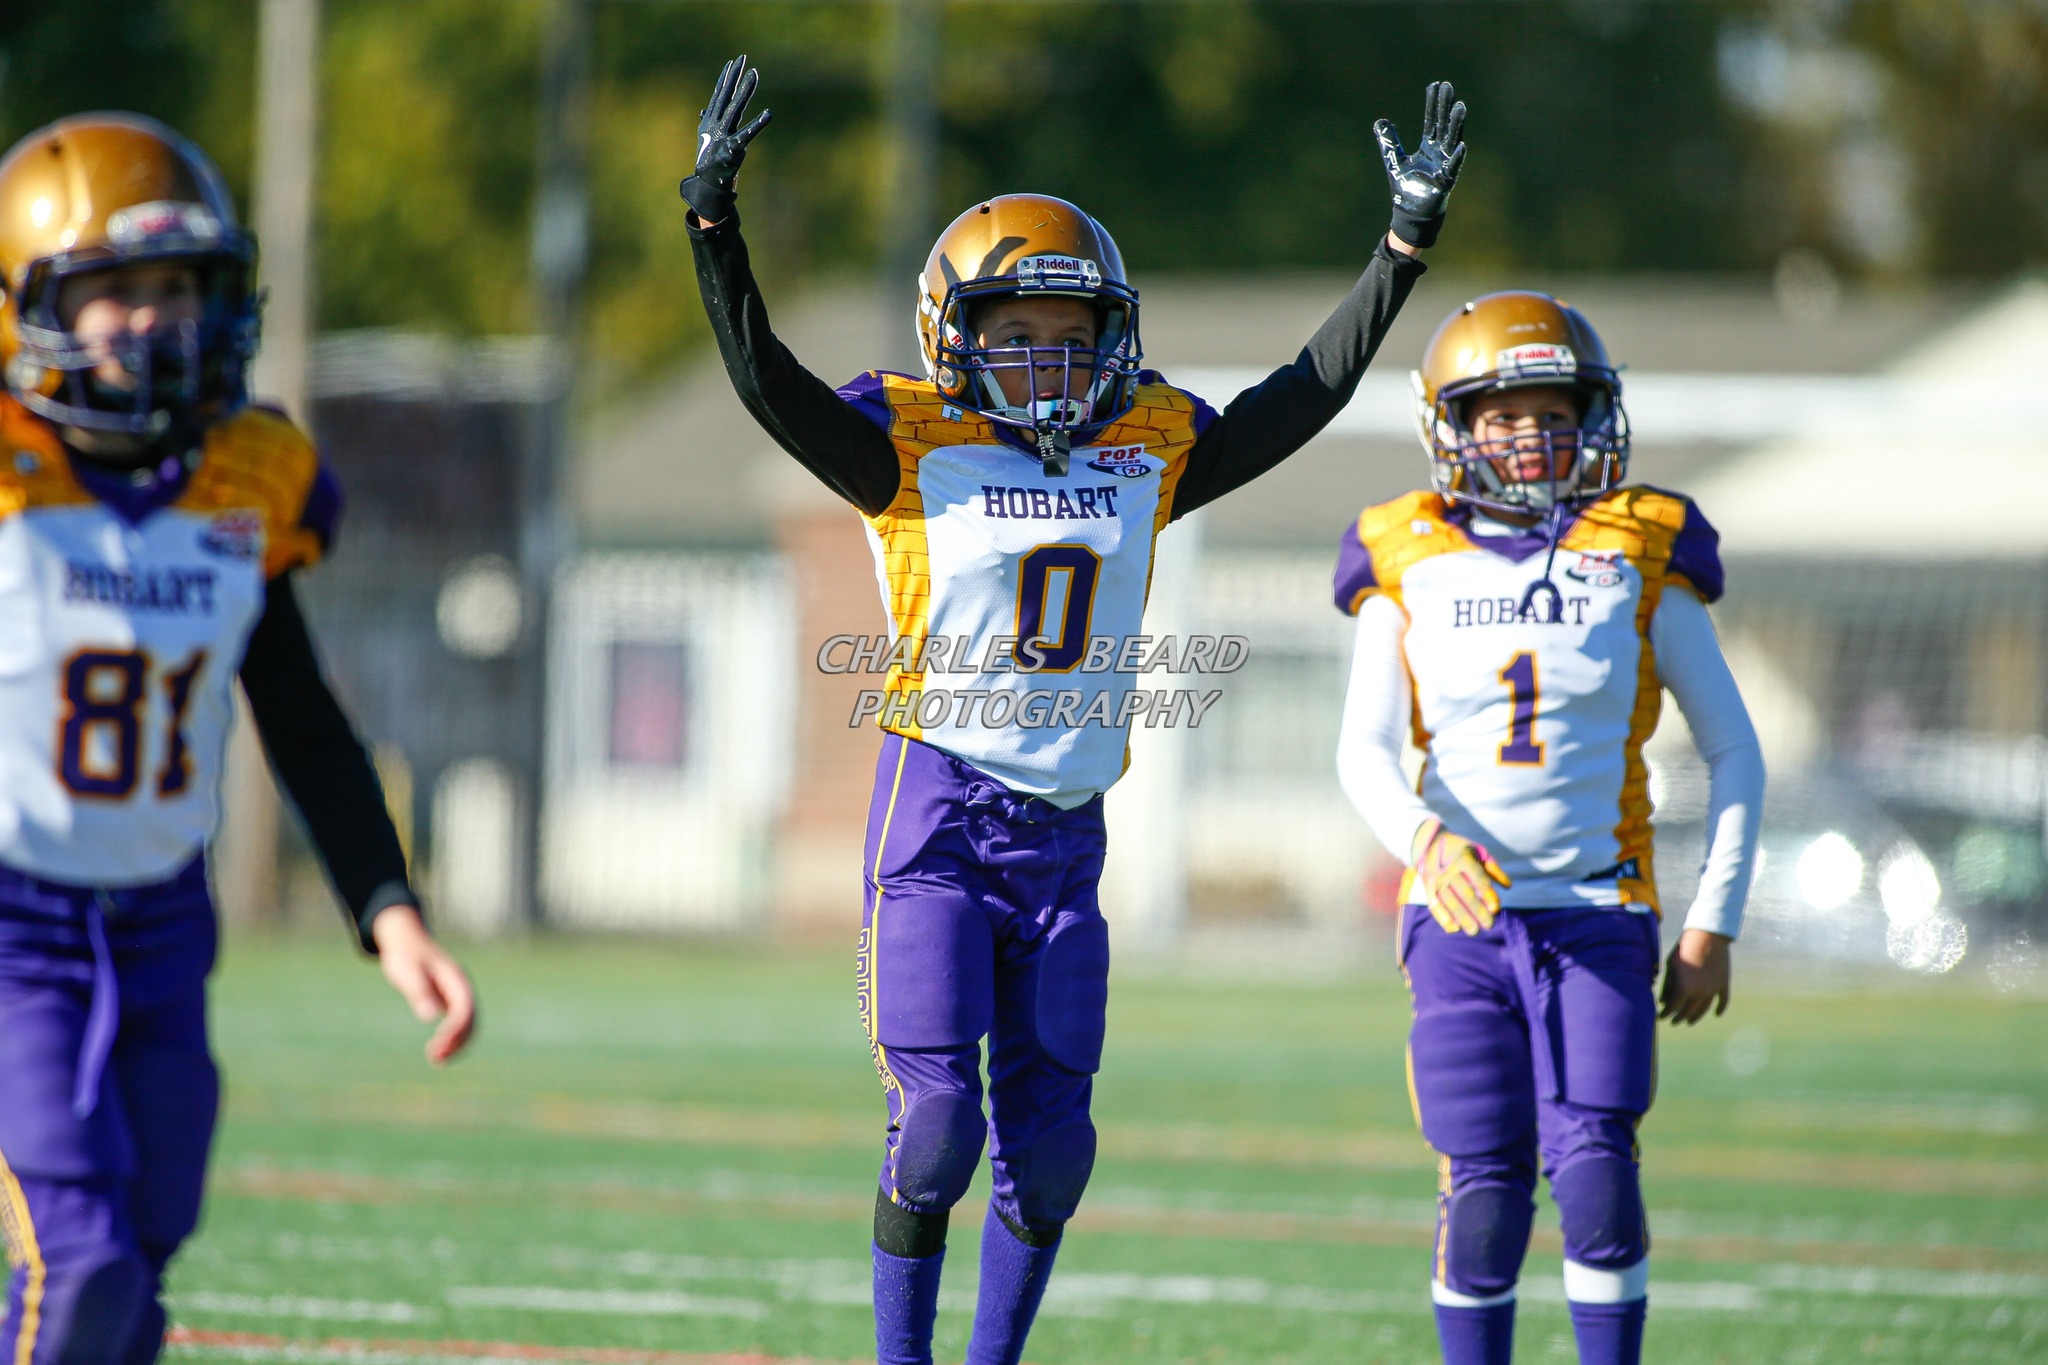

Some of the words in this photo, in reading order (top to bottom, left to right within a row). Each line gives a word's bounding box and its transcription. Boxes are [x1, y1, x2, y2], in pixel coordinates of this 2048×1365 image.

[1036, 258, 1080, 271] Riddell
[1097, 447, 1142, 461] POP
[981, 485, 1118, 519] HOBART
[1011, 543, 1104, 674] 0
[57, 645, 206, 797] 81
[1496, 648, 1546, 767] 1
